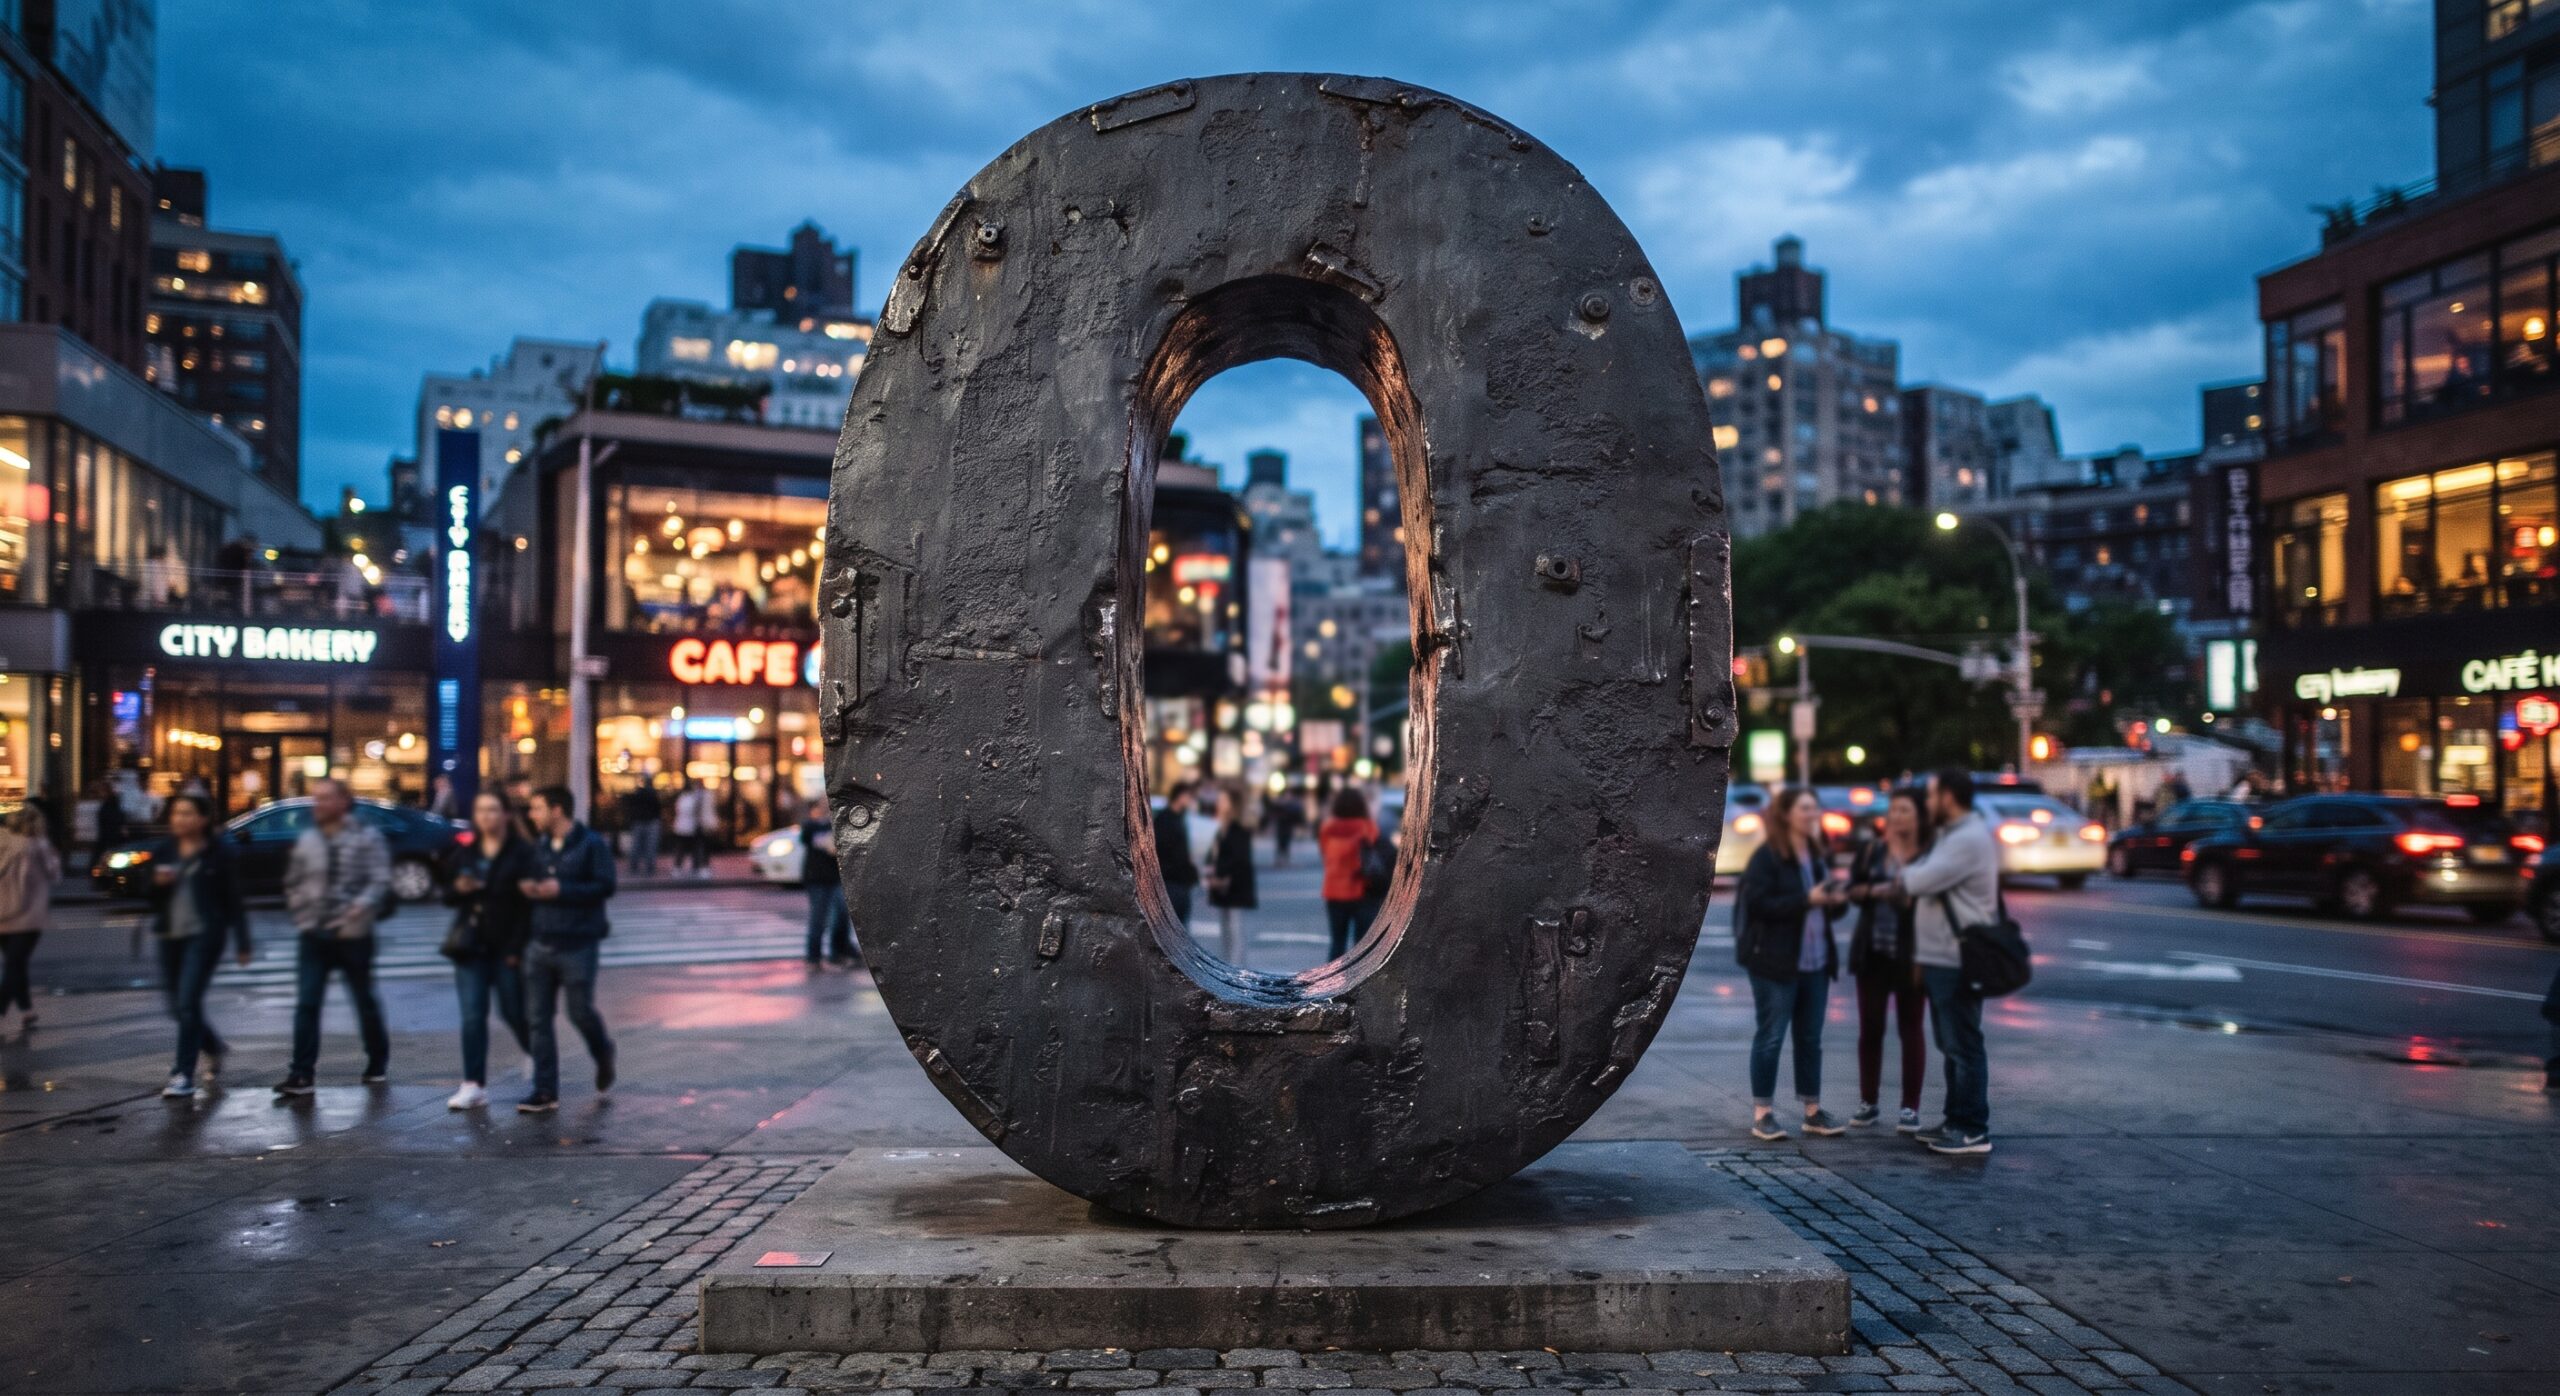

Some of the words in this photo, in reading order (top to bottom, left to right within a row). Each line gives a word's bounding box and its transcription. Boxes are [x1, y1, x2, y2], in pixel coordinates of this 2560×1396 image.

[159, 623, 239, 658] CITY
[241, 626, 378, 663] BAKERY
[669, 638, 798, 687] CAFE
[2461, 649, 2540, 693] CAFÉ
